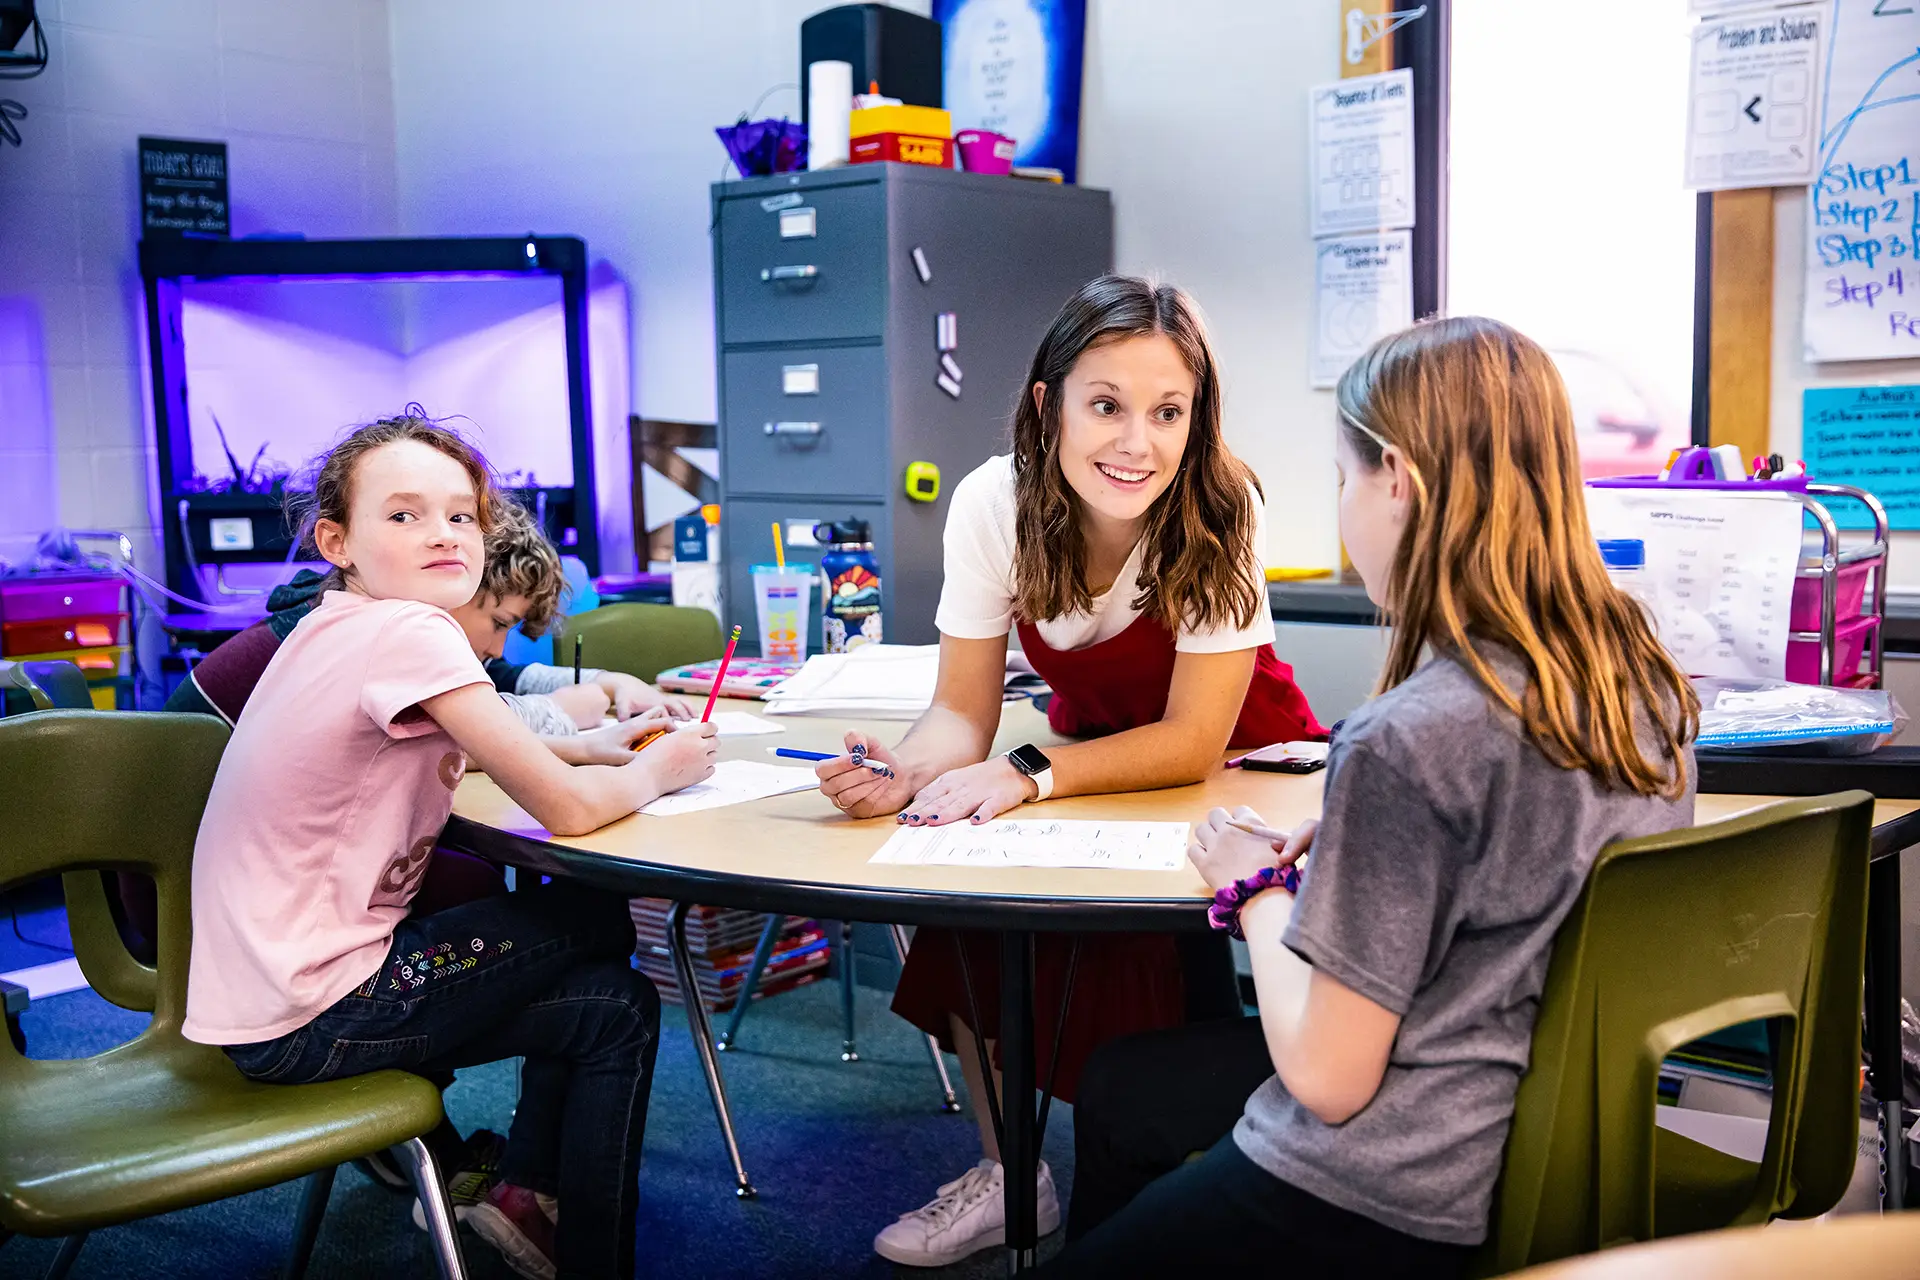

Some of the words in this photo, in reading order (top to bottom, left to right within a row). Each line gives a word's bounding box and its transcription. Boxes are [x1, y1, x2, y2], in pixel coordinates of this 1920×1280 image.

[1717, 24, 1755, 48] Problem
[1759, 21, 1776, 44] and
[1780, 16, 1818, 42] Solution
[1823, 162, 1896, 196] Step
[1896, 157, 1919, 186] 1
[1822, 200, 1879, 233] Step
[1822, 234, 1882, 269] Step
[1825, 275, 1884, 309] Step
